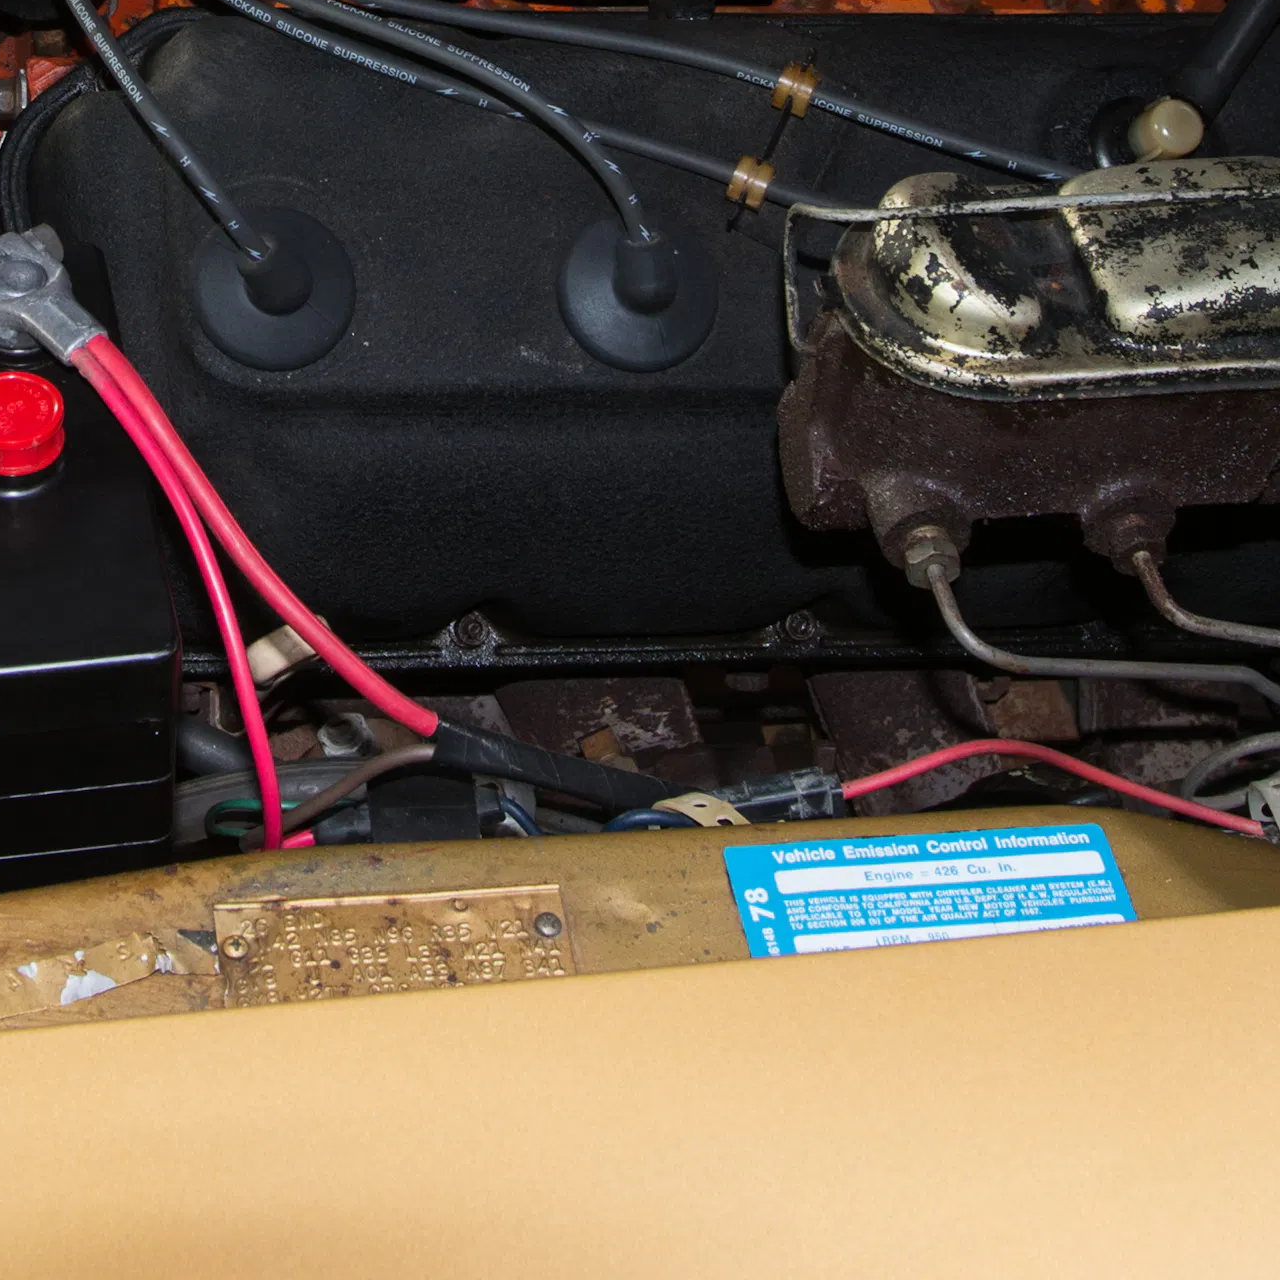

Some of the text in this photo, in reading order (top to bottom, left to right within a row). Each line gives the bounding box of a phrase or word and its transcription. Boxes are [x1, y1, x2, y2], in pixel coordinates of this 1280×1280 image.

[276, 19, 329, 50] SILICONE
[333, 45, 418, 85] SUPPRESSION
[387, 20, 441, 48] SILICONE
[447, 43, 532, 93] SUPPRESSION
[93, 32, 145, 103] SUPPRESSION
[477, 98, 489, 108] H
[736, 71, 778, 91] PACKA
[856, 113, 944, 148] SUPPRESSION
[179, 155, 191, 168] H
[1008, 160, 1018, 170] H
[628, 193, 638, 205] H
[227, 219, 239, 231] H
[772, 832, 1090, 864] Vehicle Emission Control Information
[864, 869, 913, 882] Engine
[934, 866, 958, 876] 426
[967, 864, 991, 874] Cu.
[998, 863, 1017, 872] In.
[744, 887, 775, 922] 78
[784, 899, 805, 907] THIS
[808, 896, 846, 905] VEHICLE
[850, 895, 858, 903] IS
[862, 893, 907, 902] EQUIPPED
[910, 891, 933, 899] WITH
[936, 888, 982, 897] CHRYSLER
[986, 885, 1028, 894] CLEANER
[1031, 884, 1045, 892] AIR
[1048, 881, 1084, 889] SYSTEM
[786, 907, 805, 915] AND
[808, 903, 859, 912] CONFORMS
[877, 899, 930, 908] CALIFORNIA
[934, 897, 952, 905] AND
[976, 893, 1000, 903] DEPT.
[1003, 893, 1015, 901] OF
[1052, 887, 1115, 897] REGULATIONS
[789, 911, 843, 922] APPLICABLE
[867, 909, 886, 917] 1971
[892, 907, 923, 915] MODEL
[929, 904, 953, 913] YEAR
[959, 903, 978, 911] NEW
[984, 901, 1016, 910] MOTOR
[1021, 898, 1065, 908] VEHICLES
[1070, 895, 1116, 904] PURSUANT
[790, 922, 803, 930] TO
[807, 920, 847, 929] SECTION
[884, 916, 897, 924] OF
[922, 912, 938, 921] AIR
[940, 910, 979, 920] QUALITY
[983, 909, 1001, 917] ACT
